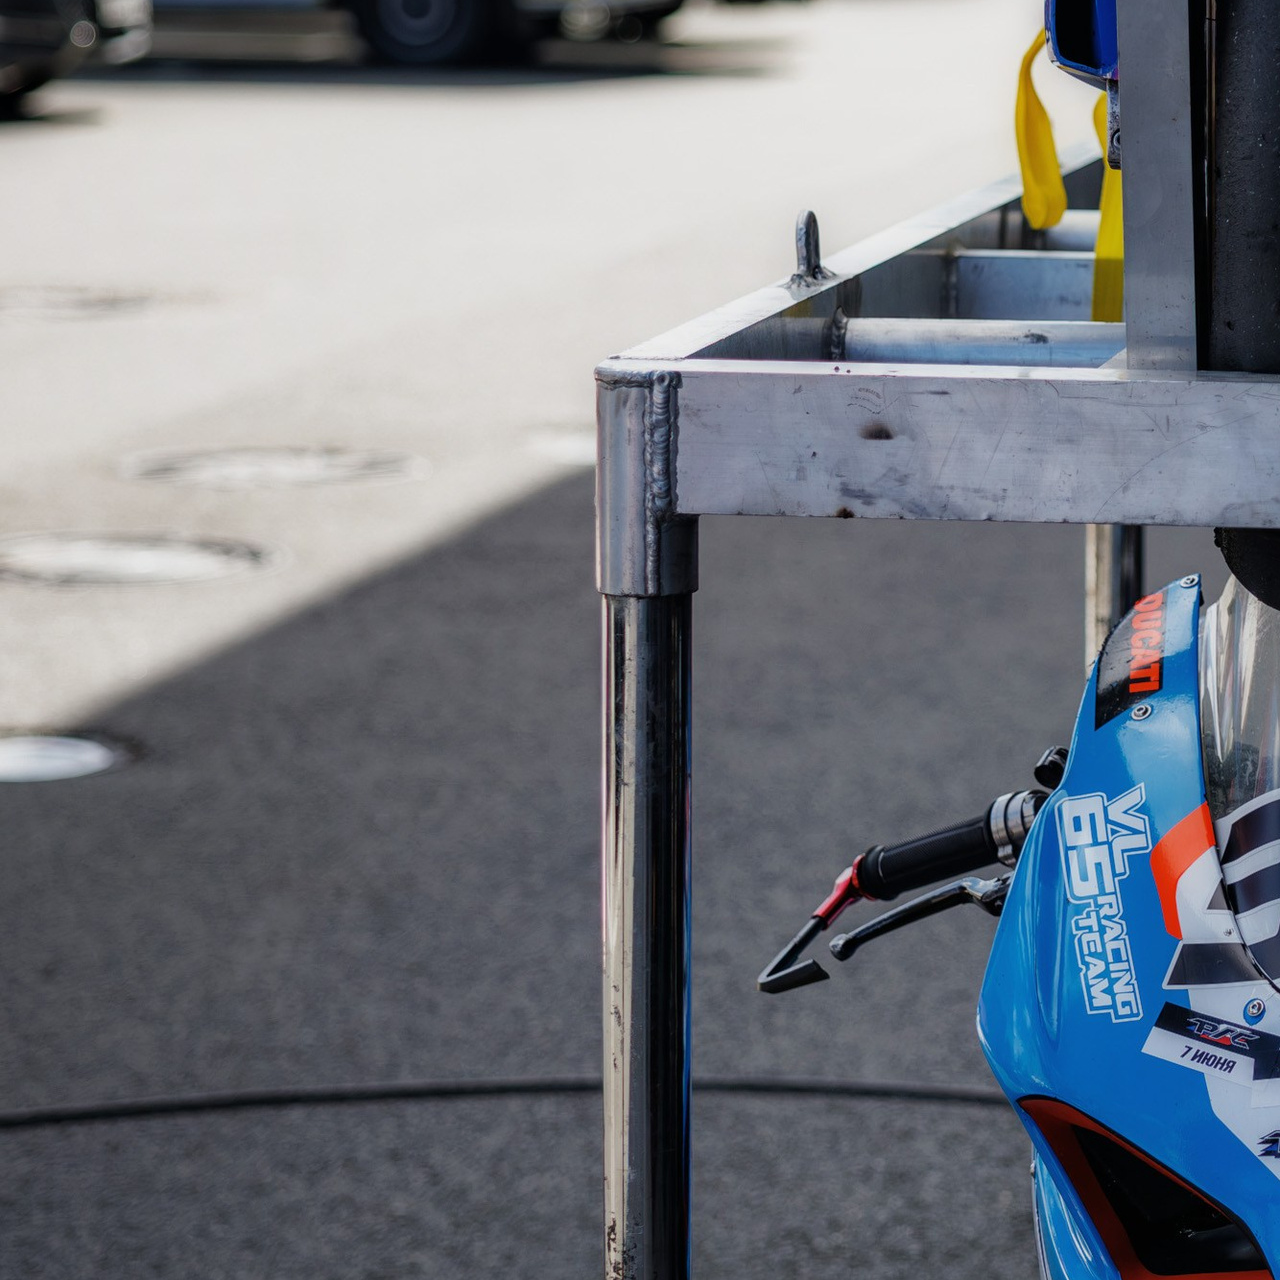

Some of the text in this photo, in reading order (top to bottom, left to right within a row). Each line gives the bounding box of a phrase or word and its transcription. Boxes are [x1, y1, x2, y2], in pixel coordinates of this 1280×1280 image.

[1129, 593, 1163, 693] DUCATI
[1061, 796, 1115, 896] 65
[1078, 910, 1112, 1008] TEAM
[1098, 894, 1138, 1016] RACING
[1180, 1045, 1237, 1073] 7 ИЮНЯ
